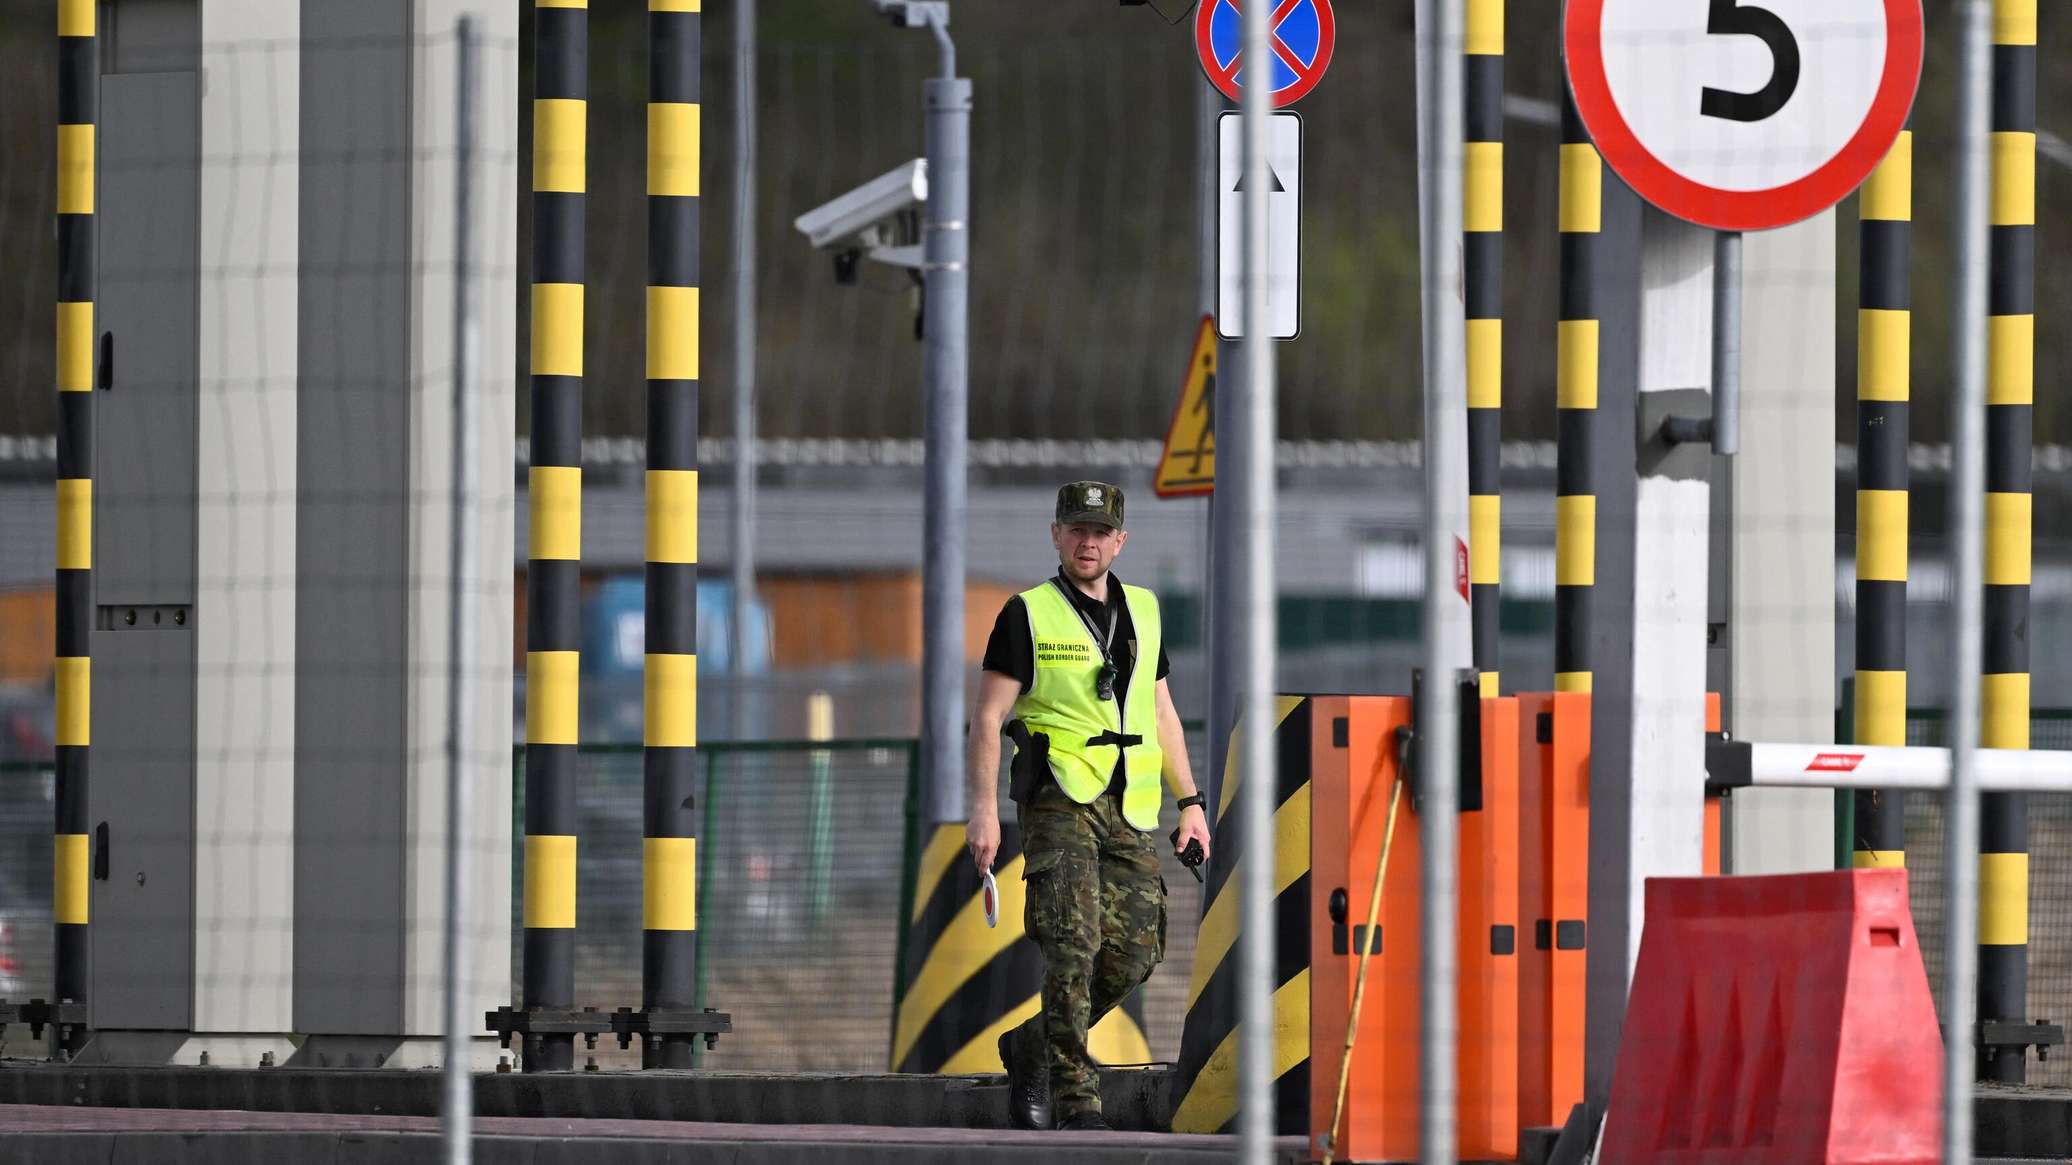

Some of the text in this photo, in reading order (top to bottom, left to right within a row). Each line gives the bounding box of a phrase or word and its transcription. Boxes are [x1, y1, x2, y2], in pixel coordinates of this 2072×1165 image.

[1700, 0, 1800, 122] 5
[1057, 643, 1090, 652] GRANICZNA
[1075, 654, 1090, 662] GUARD
